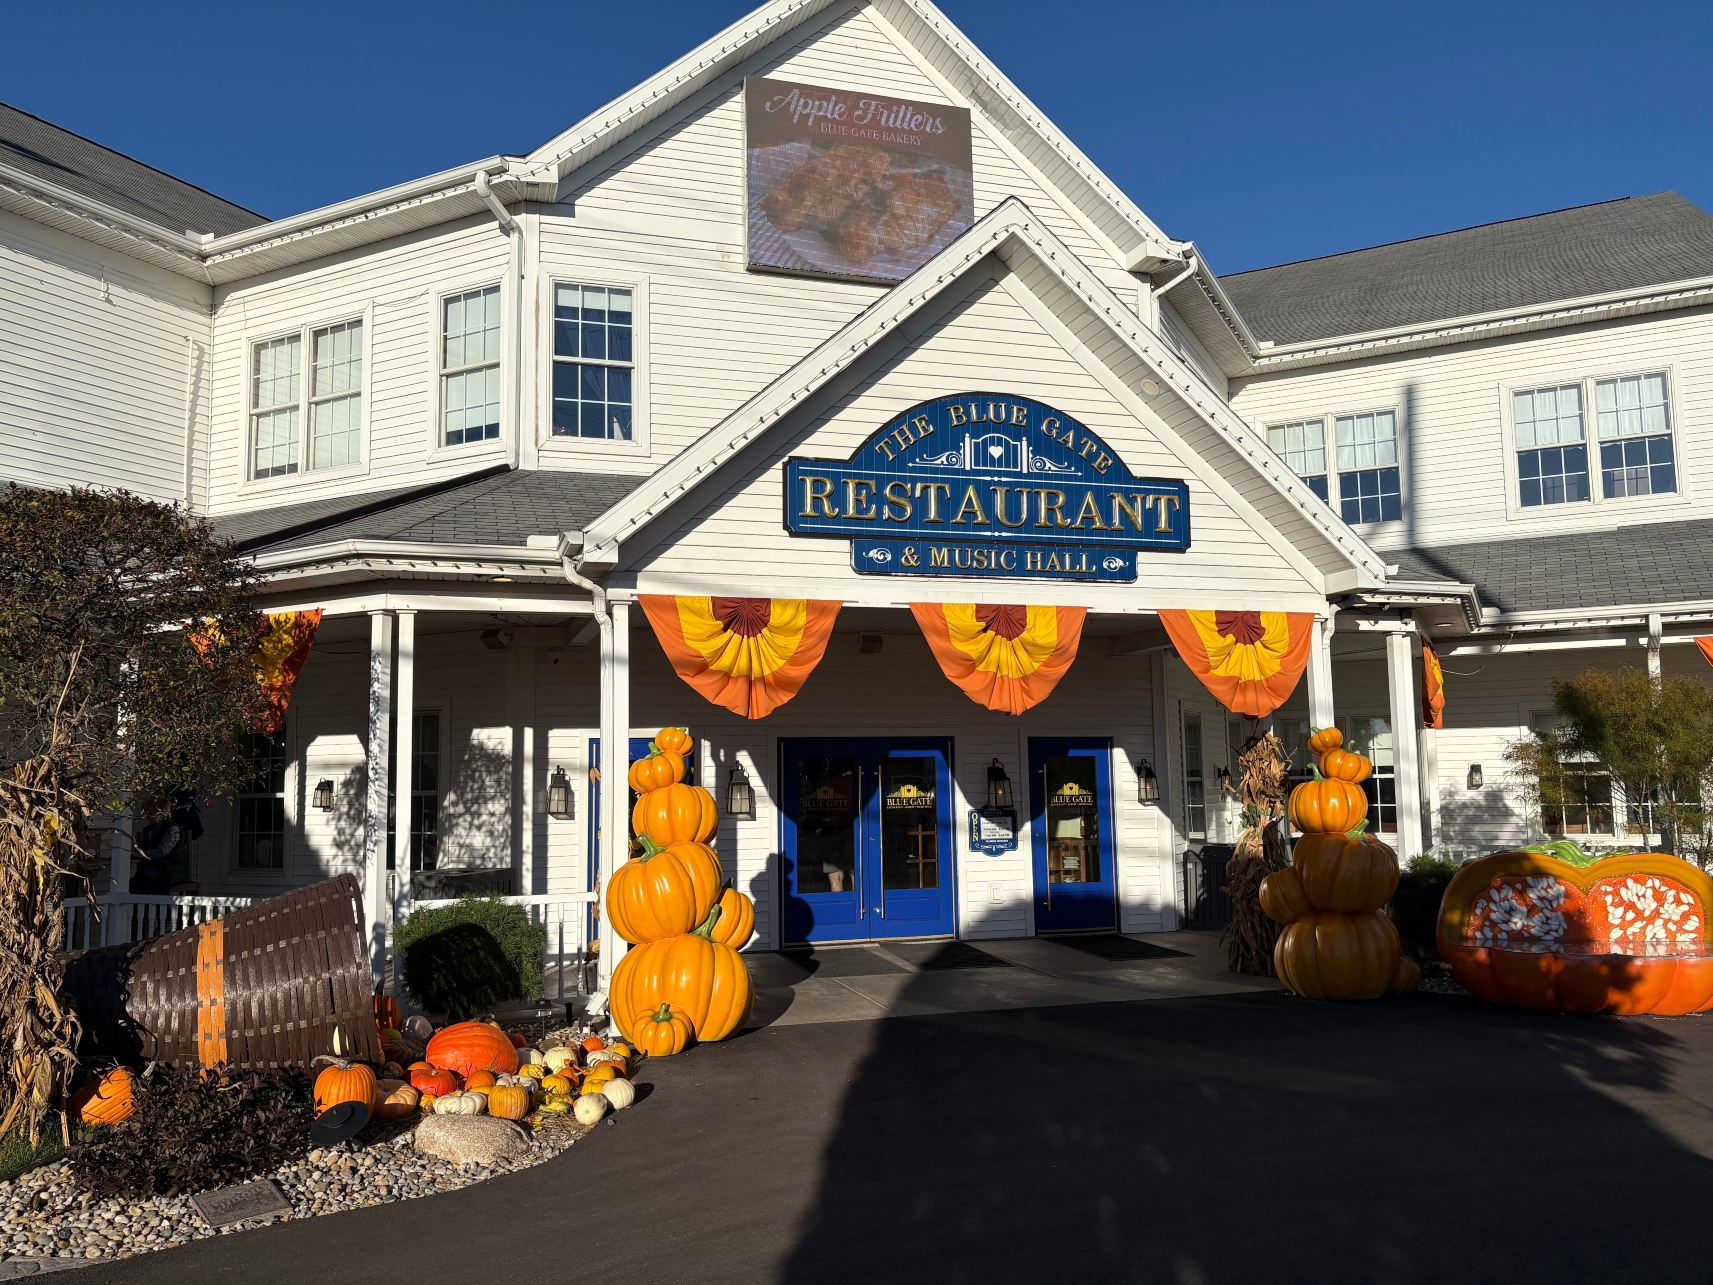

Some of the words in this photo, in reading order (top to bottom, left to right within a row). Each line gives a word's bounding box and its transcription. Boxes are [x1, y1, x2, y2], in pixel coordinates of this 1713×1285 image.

[765, 88, 848, 126] Apple
[854, 99, 946, 135] Fritters
[821, 123, 848, 136] BLUE
[851, 127, 879, 141] GATE
[882, 131, 922, 146] BAKERY
[875, 414, 934, 462] THE
[946, 401, 1028, 427] BLUE
[1040, 417, 1113, 476] GATE
[798, 476, 1180, 534] RESTAURANT
[901, 545, 920, 567] &
[928, 547, 1017, 571] MUSIC
[1024, 551, 1097, 573] HALL
[887, 798, 909, 806] BLUE
[909, 797, 933, 806] GATE
[1072, 795, 1093, 803] GATE
